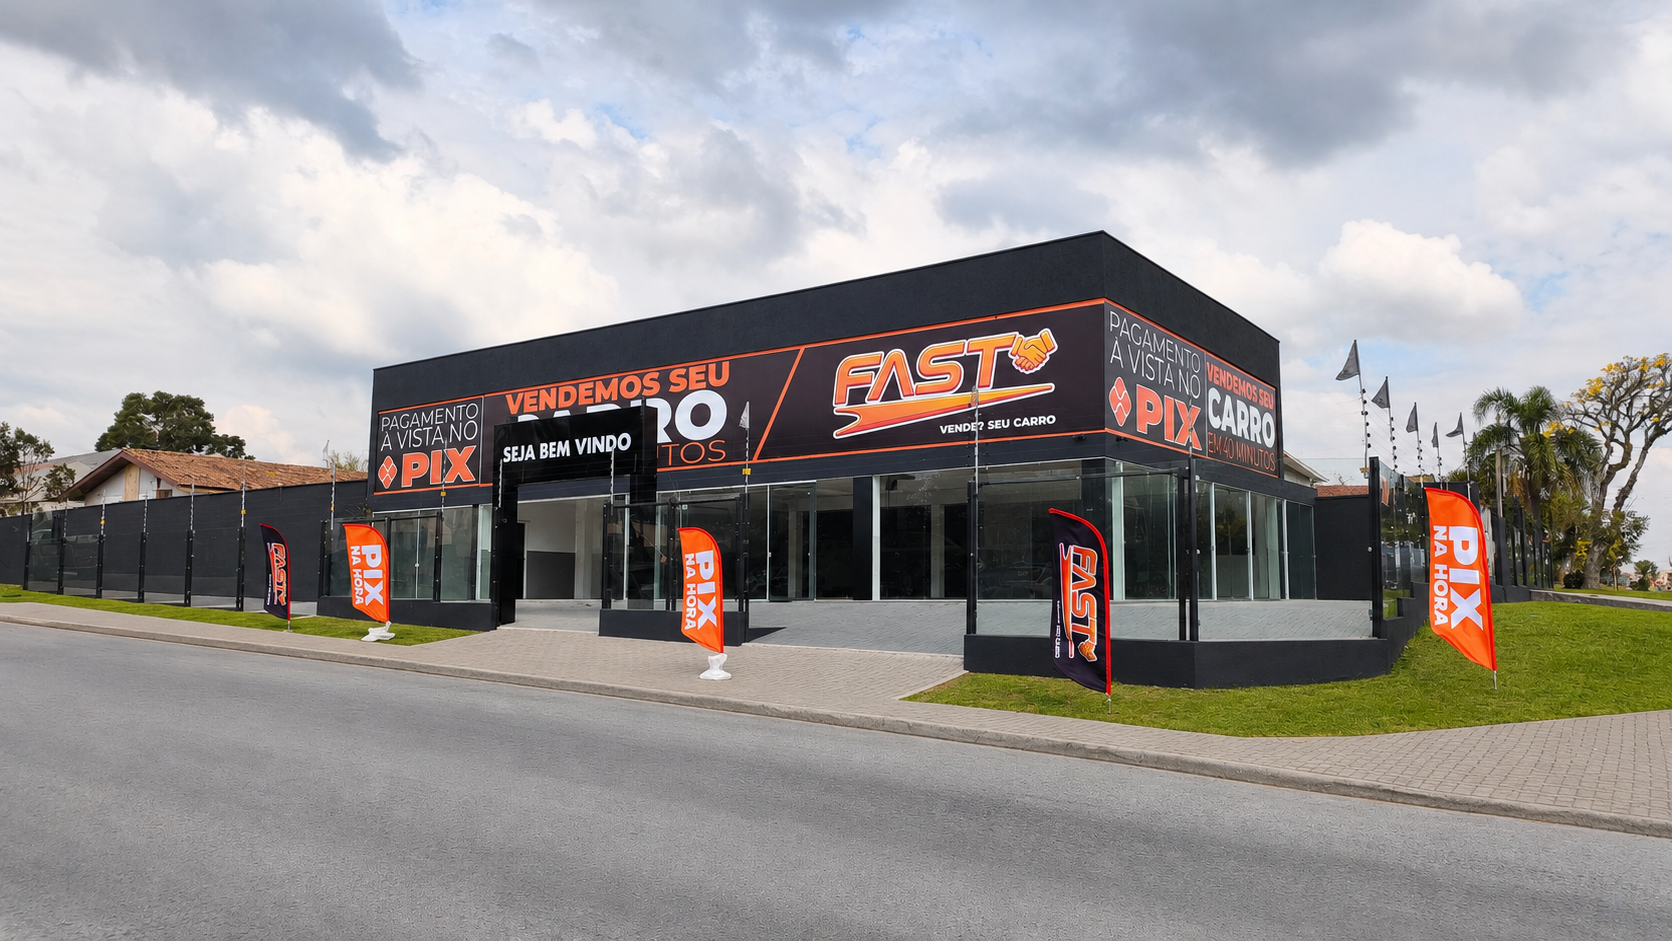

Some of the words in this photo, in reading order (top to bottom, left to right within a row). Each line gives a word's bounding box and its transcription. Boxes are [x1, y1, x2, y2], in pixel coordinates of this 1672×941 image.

[1109, 310, 1201, 374] PAGAMENTO
[505, 372, 661, 415] VENDEMOS
[668, 361, 730, 393] SEU
[833, 332, 1019, 407] FAST
[1109, 336, 1124, 369] À
[1127, 344, 1175, 391] VISTA
[1178, 368, 1201, 399] NO
[1206, 361, 1258, 403] VENDEMOS
[1258, 388, 1274, 410] SEU
[380, 431, 393, 452] À
[396, 425, 445, 450] VISTA
[449, 420, 478, 443] NO
[381, 403, 479, 432] PAGAMENTO
[987, 419, 1010, 430] SEU
[1013, 414, 1057, 428] CARRO
[1136, 383, 1203, 451] PIX
[1207, 387, 1275, 449] CARRO
[401, 445, 477, 488] PIX
[503, 444, 536, 463] SEJA
[539, 439, 571, 460] BEM
[575, 432, 632, 456] VINDO
[1207, 431, 1222, 456] EM
[1221, 436, 1234, 459] 40
[1236, 439, 1276, 472] MINUTOS
[350, 545, 361, 566] NA
[684, 553, 696, 579] NA
[1433, 525, 1448, 558] NA
[352, 568, 364, 605] HORA
[361, 544, 384, 607] PIX
[695, 550, 718, 631] PIX
[1071, 544, 1098, 645] FAST
[1433, 563, 1449, 626] HORA
[1448, 526, 1484, 631] PIX
[684, 582, 697, 630] HORA
